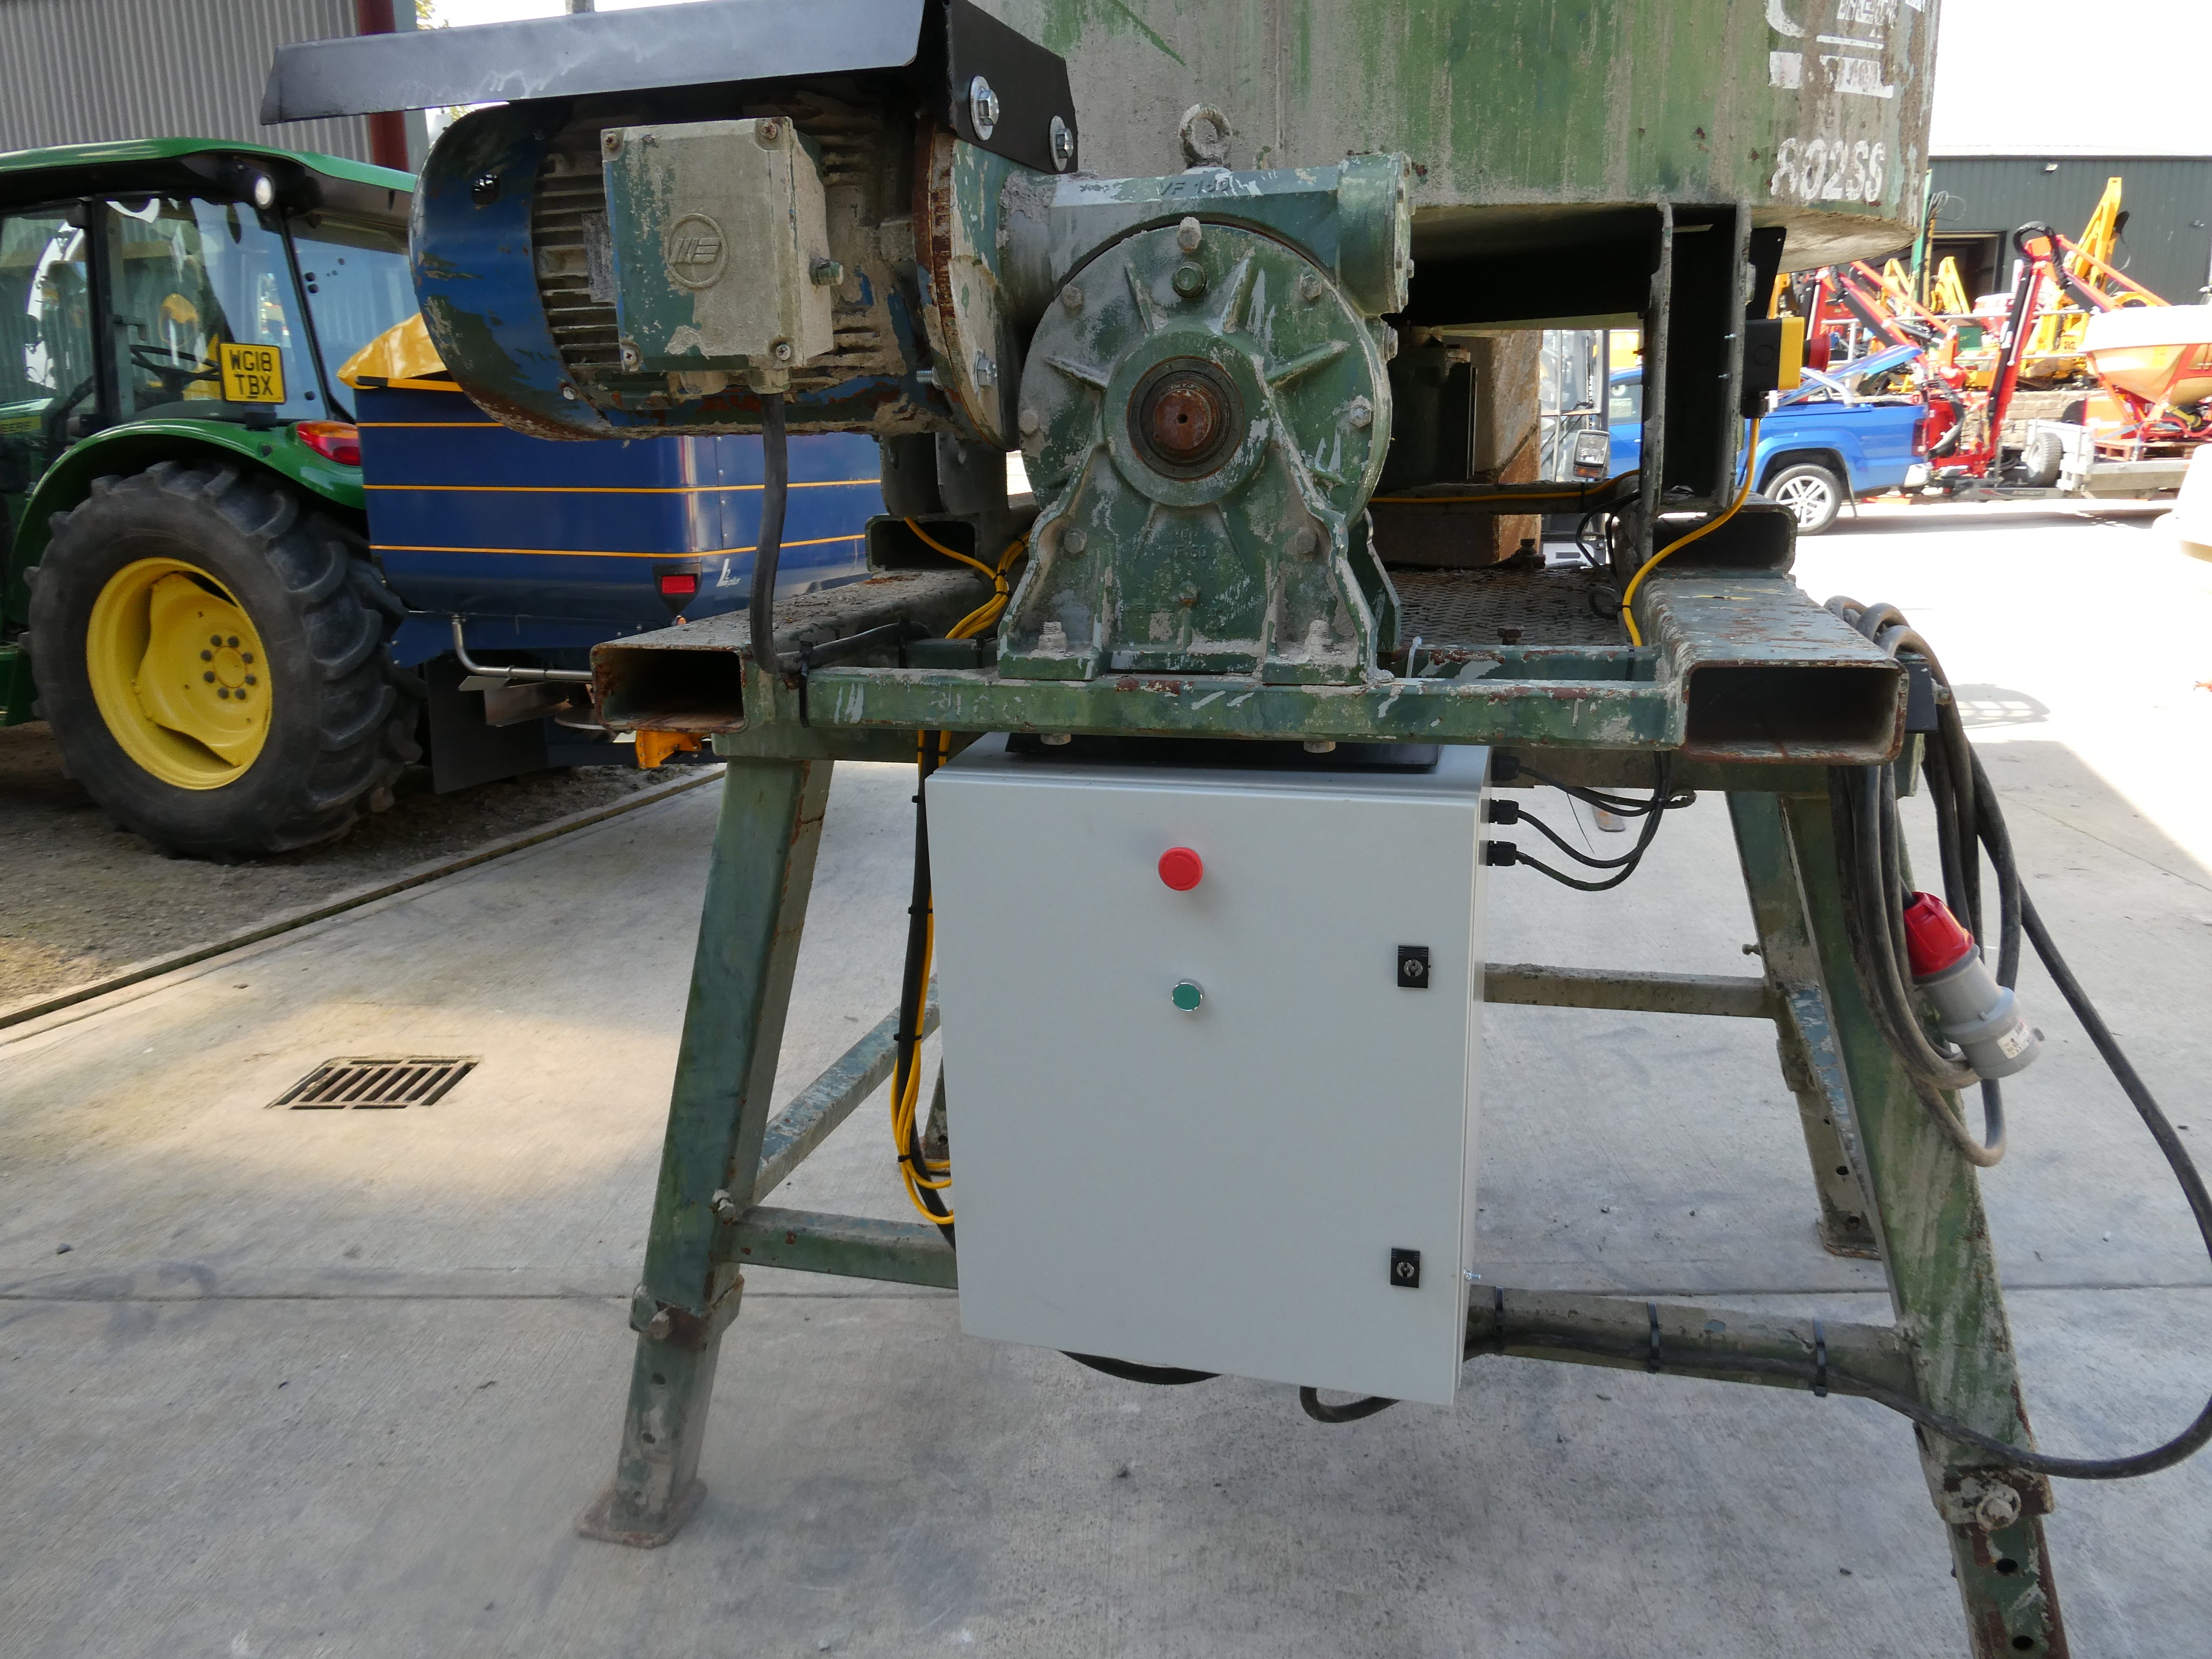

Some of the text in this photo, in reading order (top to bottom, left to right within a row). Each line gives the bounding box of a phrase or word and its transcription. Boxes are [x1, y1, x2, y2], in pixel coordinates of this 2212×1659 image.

[1157, 180, 1185, 195] VF
[229, 349, 272, 372] WG18
[234, 374, 274, 396] TBX
